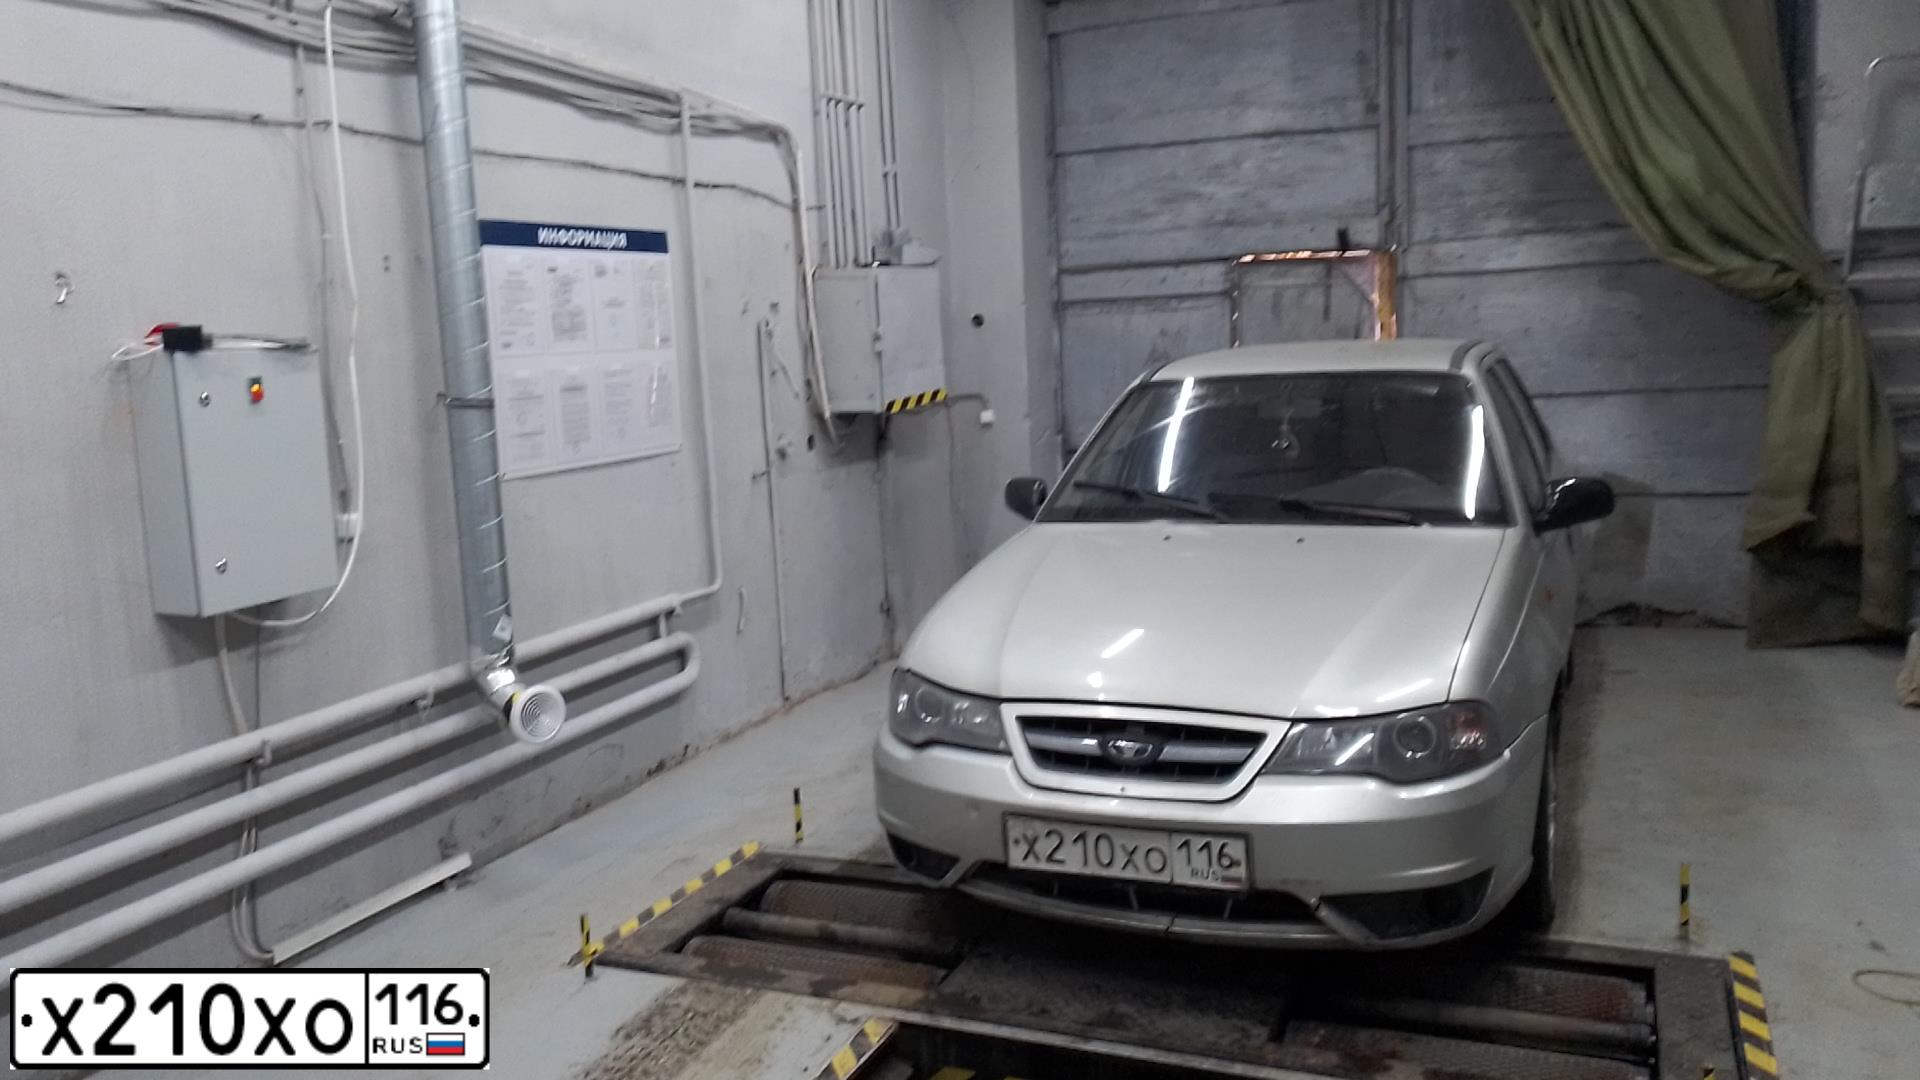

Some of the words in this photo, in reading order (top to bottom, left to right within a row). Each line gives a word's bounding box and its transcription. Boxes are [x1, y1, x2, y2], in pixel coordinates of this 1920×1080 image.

[537, 226, 628, 250] ИНФОРМАЦИЯ
[1176, 838, 1234, 870] 116
[1190, 867, 1220, 882] RUS
